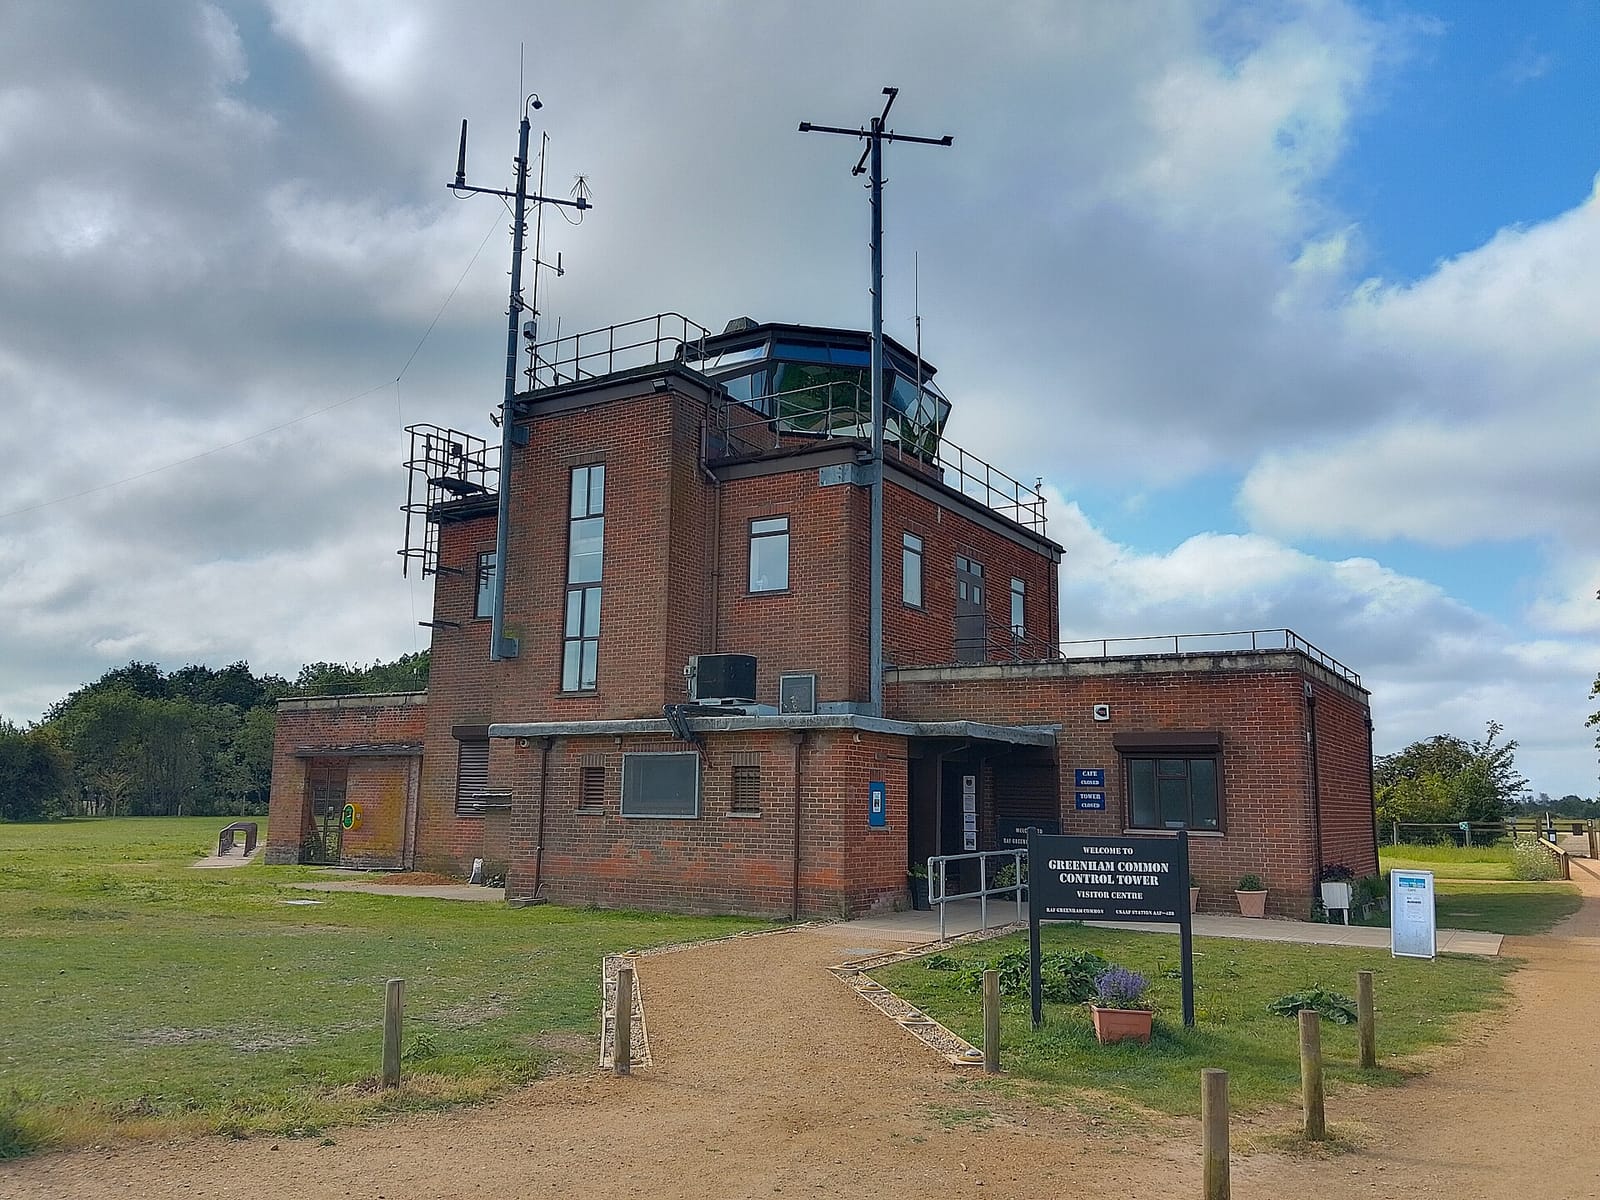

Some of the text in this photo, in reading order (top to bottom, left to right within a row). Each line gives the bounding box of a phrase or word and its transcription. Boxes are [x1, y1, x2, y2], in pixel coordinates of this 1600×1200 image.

[1083, 846, 1121, 855] WELCOME
[1048, 859, 1169, 873] GREENHAM COMMON
[1059, 873, 1160, 886] CONTROL TOWER
[1076, 890, 1144, 900] VISITOR CENTRE
